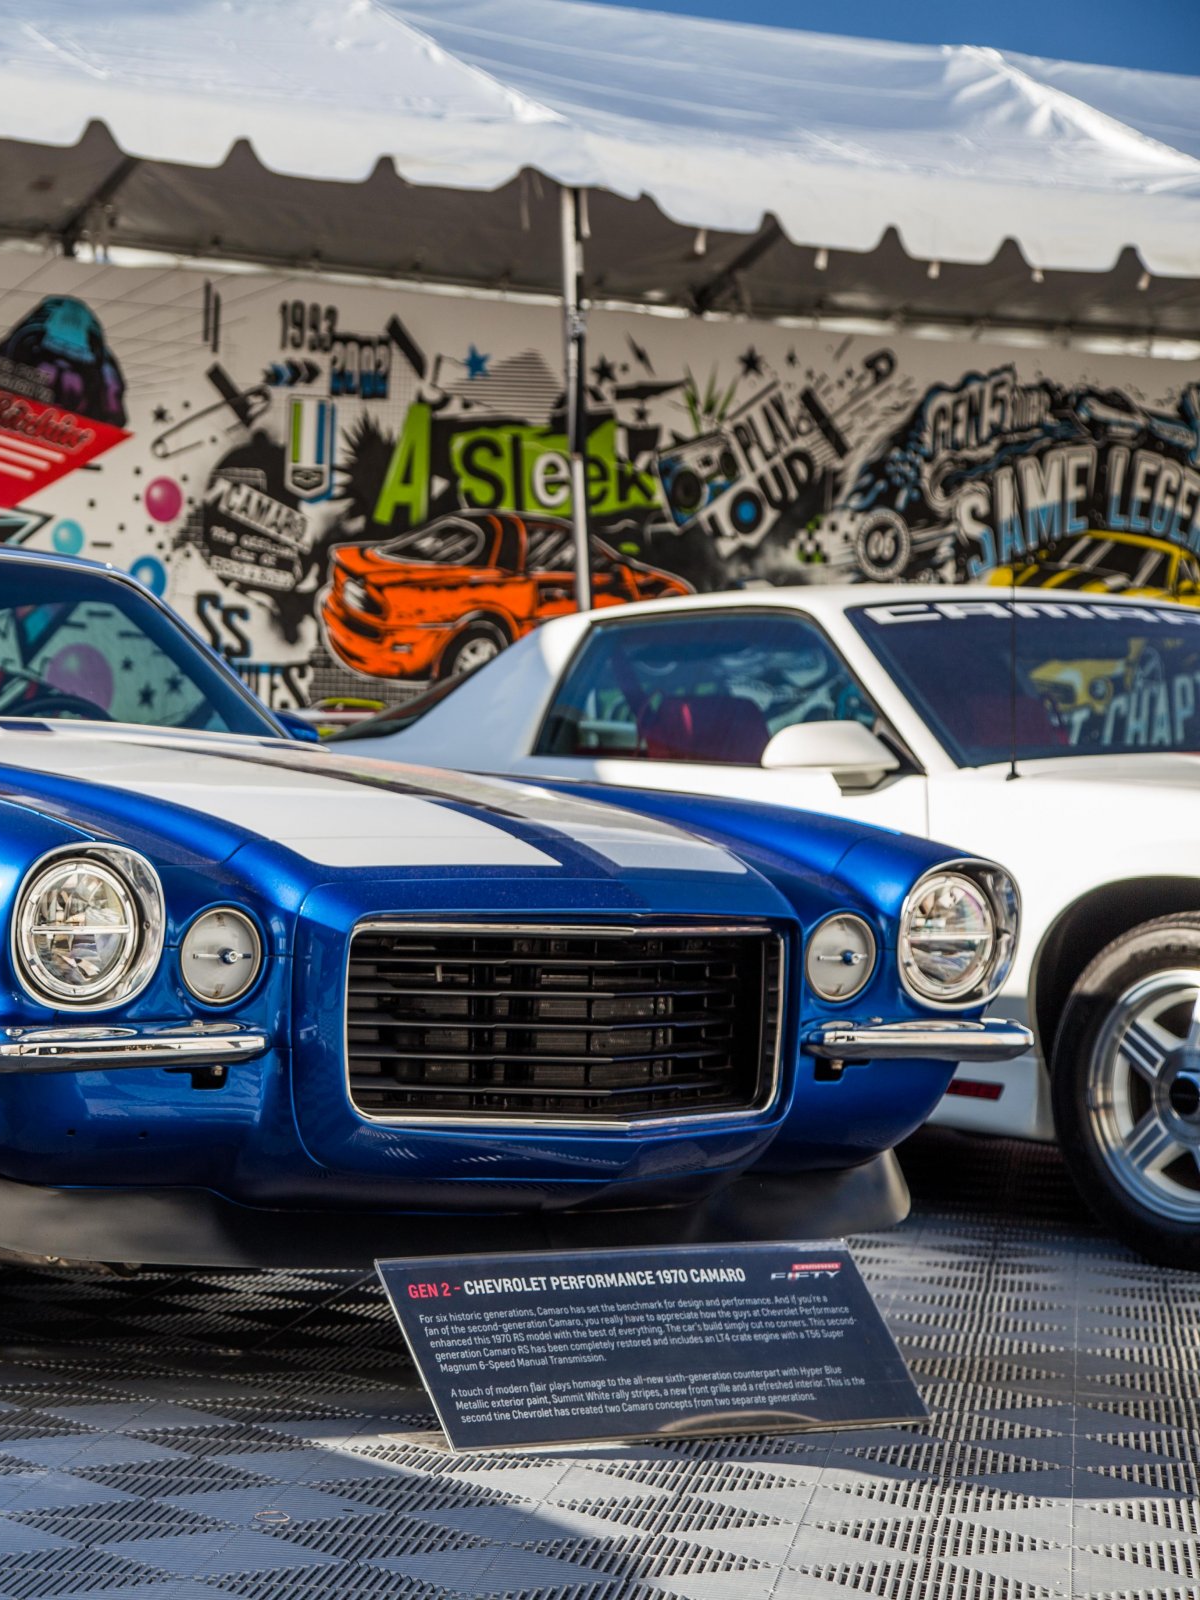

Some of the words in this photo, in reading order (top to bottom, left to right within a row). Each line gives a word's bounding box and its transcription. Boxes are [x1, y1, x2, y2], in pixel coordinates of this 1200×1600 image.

[280, 300, 338, 352] 1993
[330, 341, 391, 399] 2002
[373, 403, 431, 525] A
[461, 432, 656, 510] Sleek
[955, 443, 1098, 578] SAME
[1103, 675, 1200, 746] CHAP
[408, 1283, 439, 1299] GEN
[441, 1282, 452, 1297] 2
[463, 1276, 547, 1296] CHEVROLET
[549, 1270, 656, 1291] PERFORMANCE
[655, 1268, 689, 1285] 1970
[689, 1267, 746, 1283] CAMARO
[418, 1314, 433, 1324] For
[435, 1313, 448, 1323] six
[448, 1312, 482, 1322] historic
[483, 1308, 537, 1322] generations,
[536, 1306, 570, 1316] Camaro
[569, 1304, 586, 1314] has
[586, 1304, 601, 1314] set
[600, 1303, 616, 1312] the
[615, 1300, 664, 1312] benchmark
[663, 1298, 676, 1309] for
[677, 1298, 705, 1309] design
[705, 1297, 721, 1307] and
[720, 1296, 774, 1308] performance.
[774, 1295, 790, 1304] And
[424, 1326, 440, 1338] fan
[440, 1324, 450, 1336] of
[450, 1325, 466, 1334] the
[467, 1320, 548, 1333] second-generation
[548, 1318, 584, 1328] Camaro,
[584, 1318, 600, 1328] you
[600, 1315, 624, 1326] really
[624, 1314, 645, 1323] have
[656, 1311, 699, 1323] appreciate
[699, 1310, 717, 1319] how
[717, 1310, 731, 1318] the
[732, 1310, 752, 1320] guys
[760, 1307, 799, 1317] Chevrolet
[798, 1305, 850, 1315] Performance
[429, 1336, 473, 1349] enhanced
[473, 1335, 491, 1345] this
[491, 1333, 512, 1344] 1970
[512, 1332, 525, 1342] RS
[526, 1331, 553, 1341] model
[553, 1330, 573, 1340] with
[572, 1329, 588, 1338] the
[587, 1328, 608, 1338] best
[608, 1326, 617, 1337] of
[618, 1325, 664, 1337] everything.
[665, 1323, 683, 1333] The
[702, 1321, 724, 1331] build
[723, 1320, 749, 1331] simply
[750, 1320, 764, 1329] cut
[775, 1319, 807, 1328] corners.
[808, 1317, 826, 1326] This
[434, 1350, 483, 1363] generation
[482, 1347, 517, 1358] Camaro
[517, 1344, 530, 1354] RS
[530, 1344, 547, 1354] has
[547, 1343, 569, 1353] been
[569, 1340, 615, 1352] completely
[616, 1337, 652, 1348] restored
[652, 1336, 669, 1346] and
[669, 1335, 704, 1345] includes
[715, 1333, 731, 1343] LT4
[731, 1333, 753, 1342] crate
[753, 1333, 781, 1343] engine
[780, 1331, 799, 1340] with
[821, 1329, 844, 1340] Super
[439, 1363, 479, 1374] Magnum
[478, 1358, 516, 1372] 6-Speed
[516, 1356, 549, 1367] Manual
[548, 1354, 607, 1365] Transmission.
[451, 1388, 458, 1398] A
[457, 1386, 484, 1398] touch
[484, 1384, 494, 1396] of
[495, 1384, 530, 1395] modern
[529, 1381, 547, 1393] flair
[548, 1381, 572, 1393] plays
[571, 1379, 607, 1390] homage
[616, 1376, 632, 1386] the
[633, 1375, 664, 1385] all-new
[664, 1371, 733, 1384] sixth-generation
[732, 1368, 781, 1379] counterpart
[781, 1367, 800, 1376] with
[799, 1366, 823, 1377] Hyper
[823, 1365, 842, 1375] Blue
[455, 1399, 490, 1411] Metallic
[490, 1398, 525, 1408] exterior
[526, 1395, 552, 1408] paint,
[551, 1393, 585, 1404] Summit
[585, 1391, 611, 1401] White
[611, 1389, 630, 1401] rally
[630, 1389, 663, 1400] stripes,
[669, 1387, 687, 1396] new
[687, 1385, 710, 1396] front
[709, 1383, 731, 1396] grille
[732, 1382, 748, 1392] and
[754, 1379, 794, 1391] refreshed
[794, 1380, 826, 1389] interior.
[825, 1377, 844, 1387] This
[851, 1376, 866, 1386] the
[460, 1412, 493, 1424] second
[511, 1408, 554, 1420] Chevrolet
[553, 1407, 571, 1417] has
[570, 1404, 604, 1416] created
[604, 1405, 621, 1414] two
[621, 1402, 654, 1413] Camaro
[654, 1399, 694, 1411] concepts
[693, 1397, 714, 1409] from
[714, 1397, 731, 1406] two
[731, 1395, 767, 1407] separate
[767, 1393, 817, 1406] generations.
